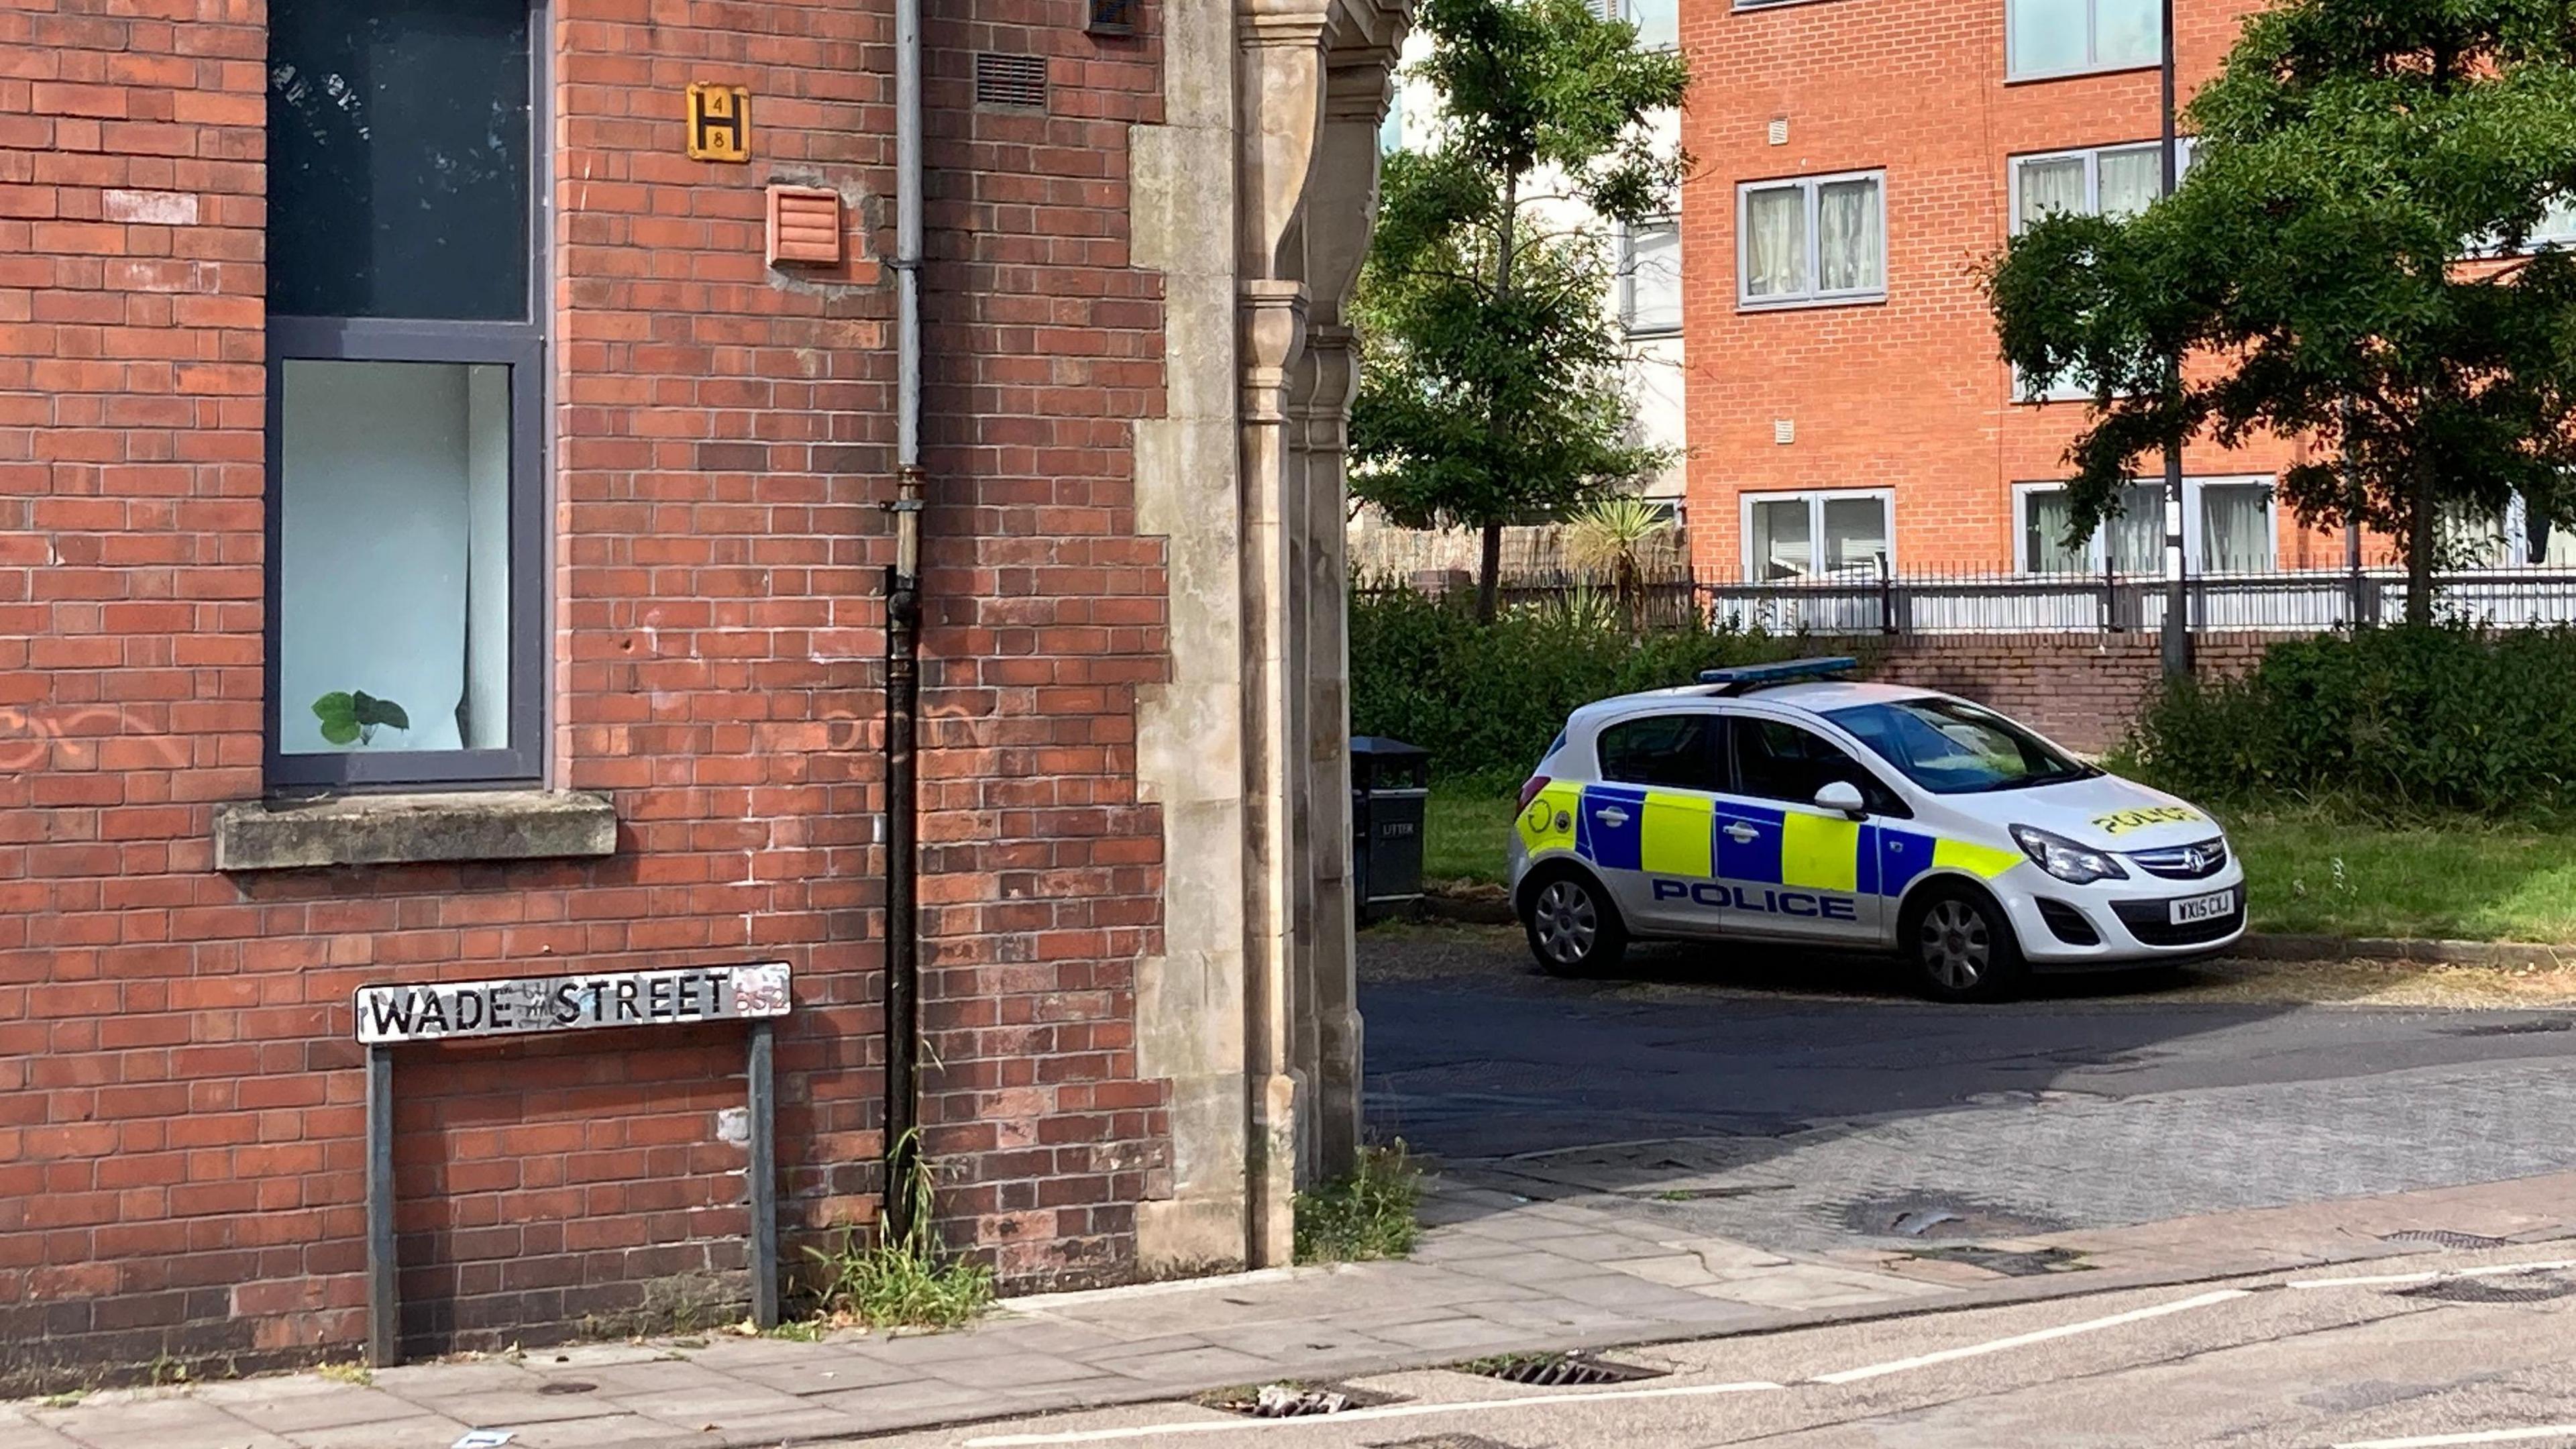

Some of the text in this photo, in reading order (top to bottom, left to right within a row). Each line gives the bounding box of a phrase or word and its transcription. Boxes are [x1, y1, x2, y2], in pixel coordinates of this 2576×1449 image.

[713, 96, 722, 113] 4
[696, 92, 741, 152] H
[714, 131, 724, 148] 8
[1652, 879, 1857, 921] POLICE
[2208, 894, 2229, 915] CXJ
[370, 987, 513, 1035] WADE
[555, 975, 729, 1024] STREET
